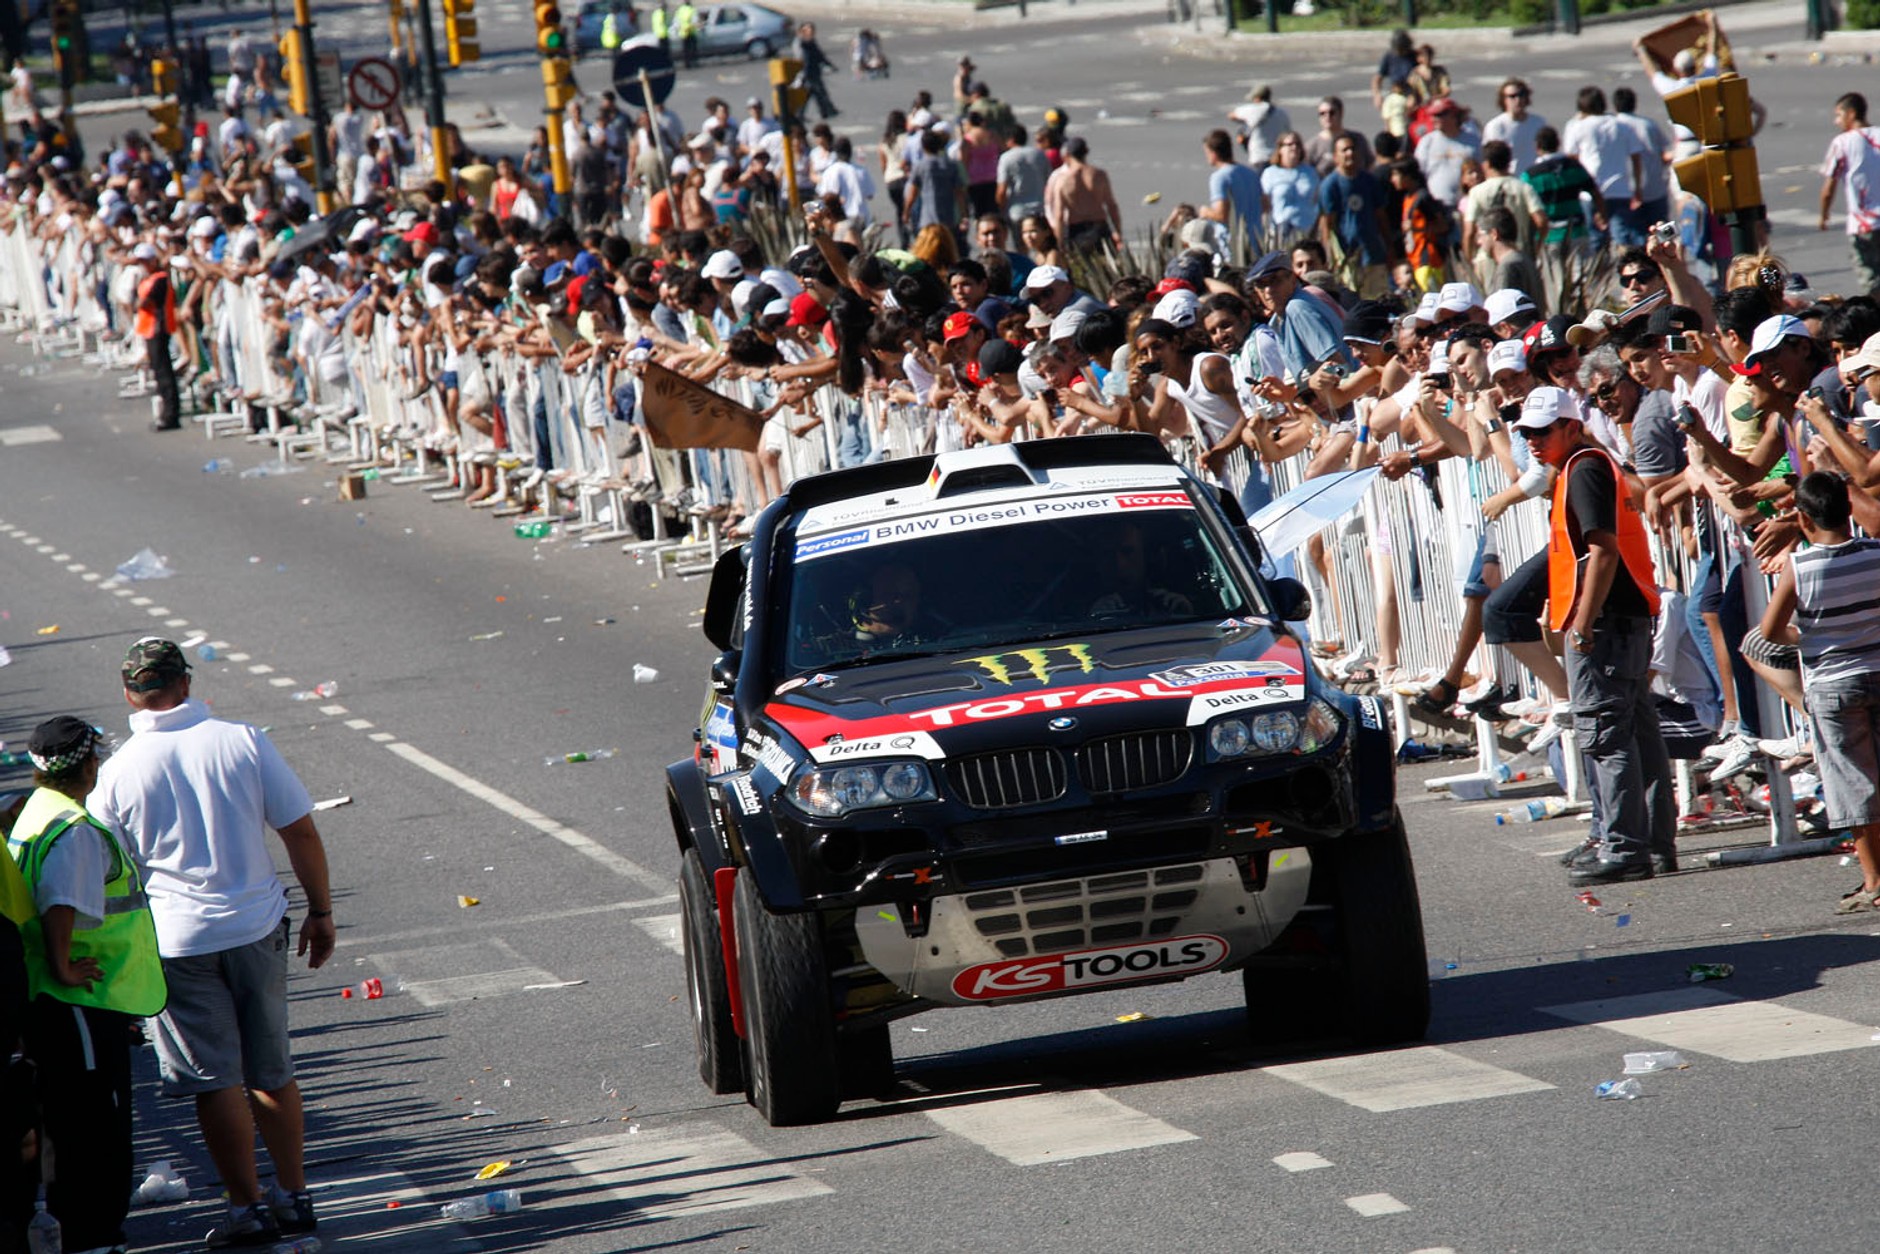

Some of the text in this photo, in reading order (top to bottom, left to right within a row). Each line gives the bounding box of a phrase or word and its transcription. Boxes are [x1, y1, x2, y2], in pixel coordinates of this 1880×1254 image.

[1117, 496, 1190, 505] TOTAL
[797, 532, 867, 552] Personal
[877, 518, 940, 539] BMW
[950, 506, 1026, 526] Diesel
[1034, 498, 1110, 514] Power
[1195, 664, 1238, 675] 301
[909, 684, 1193, 726] TOTAL
[1206, 692, 1260, 708] Delta
[830, 741, 881, 756] Delta
[972, 943, 1206, 995] KS TOOLS
